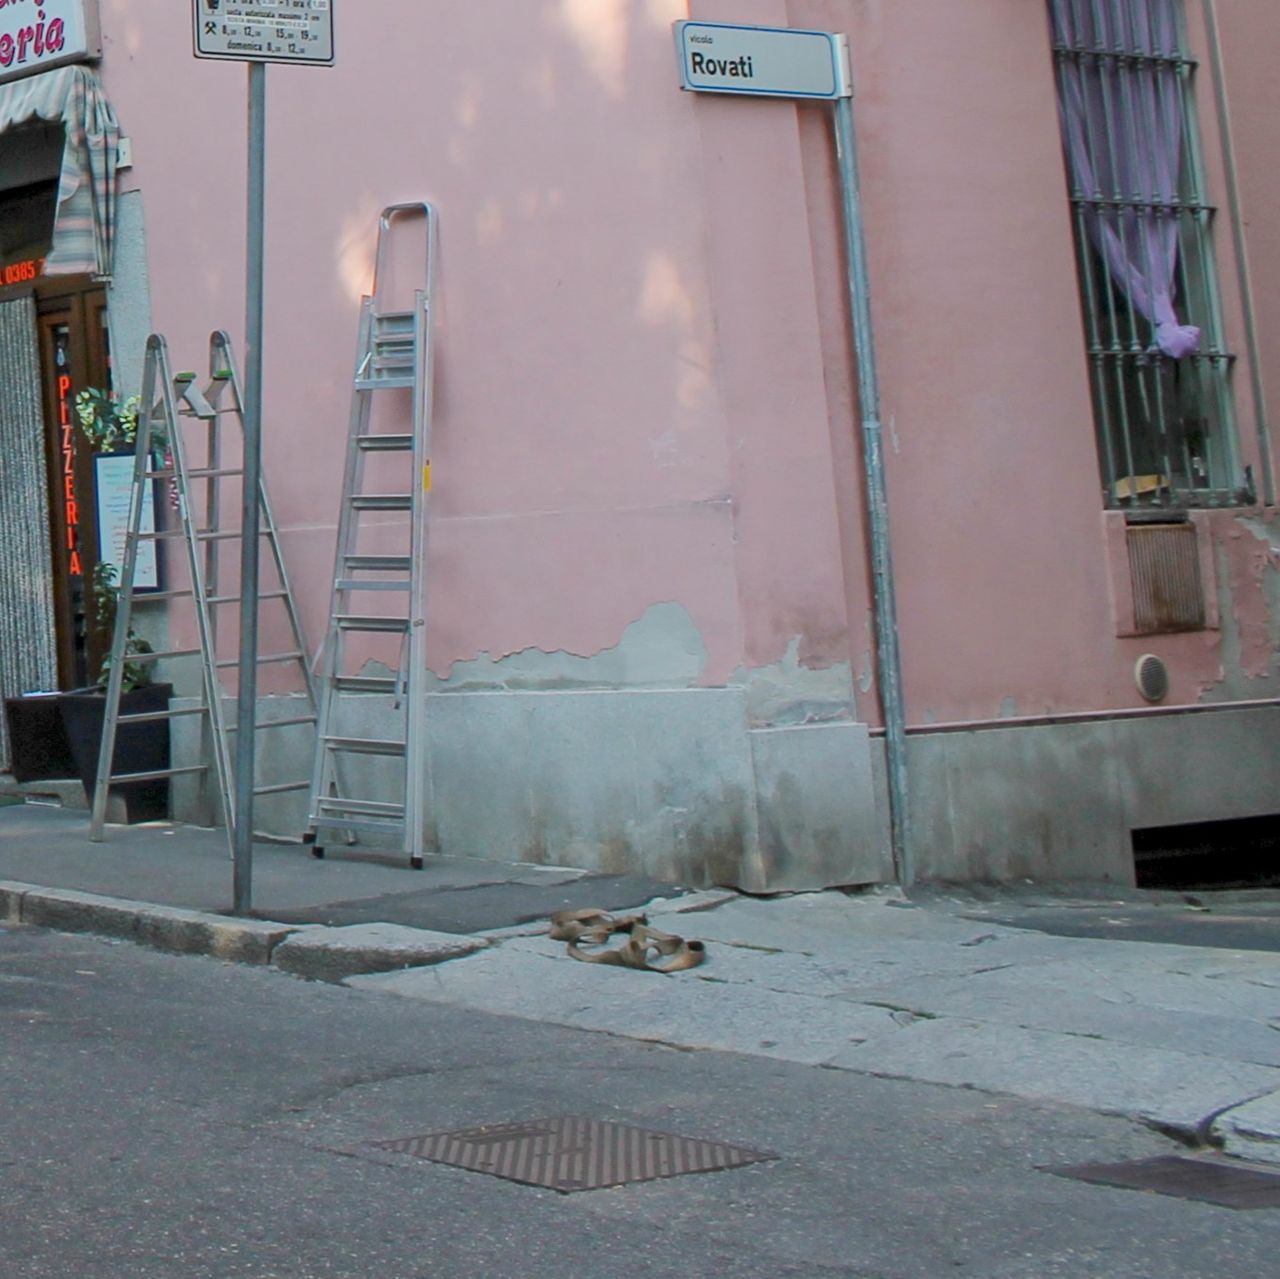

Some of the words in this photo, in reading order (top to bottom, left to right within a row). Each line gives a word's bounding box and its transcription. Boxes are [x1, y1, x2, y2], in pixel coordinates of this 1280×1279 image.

[293, 0, 305, 8] ora
[227, 40, 262, 52] domenica
[690, 35, 713, 45] vicolo
[691, 52, 753, 78] Rovati
[6, 260, 36, 284] 0385
[58, 375, 82, 576] PIZZERIA
